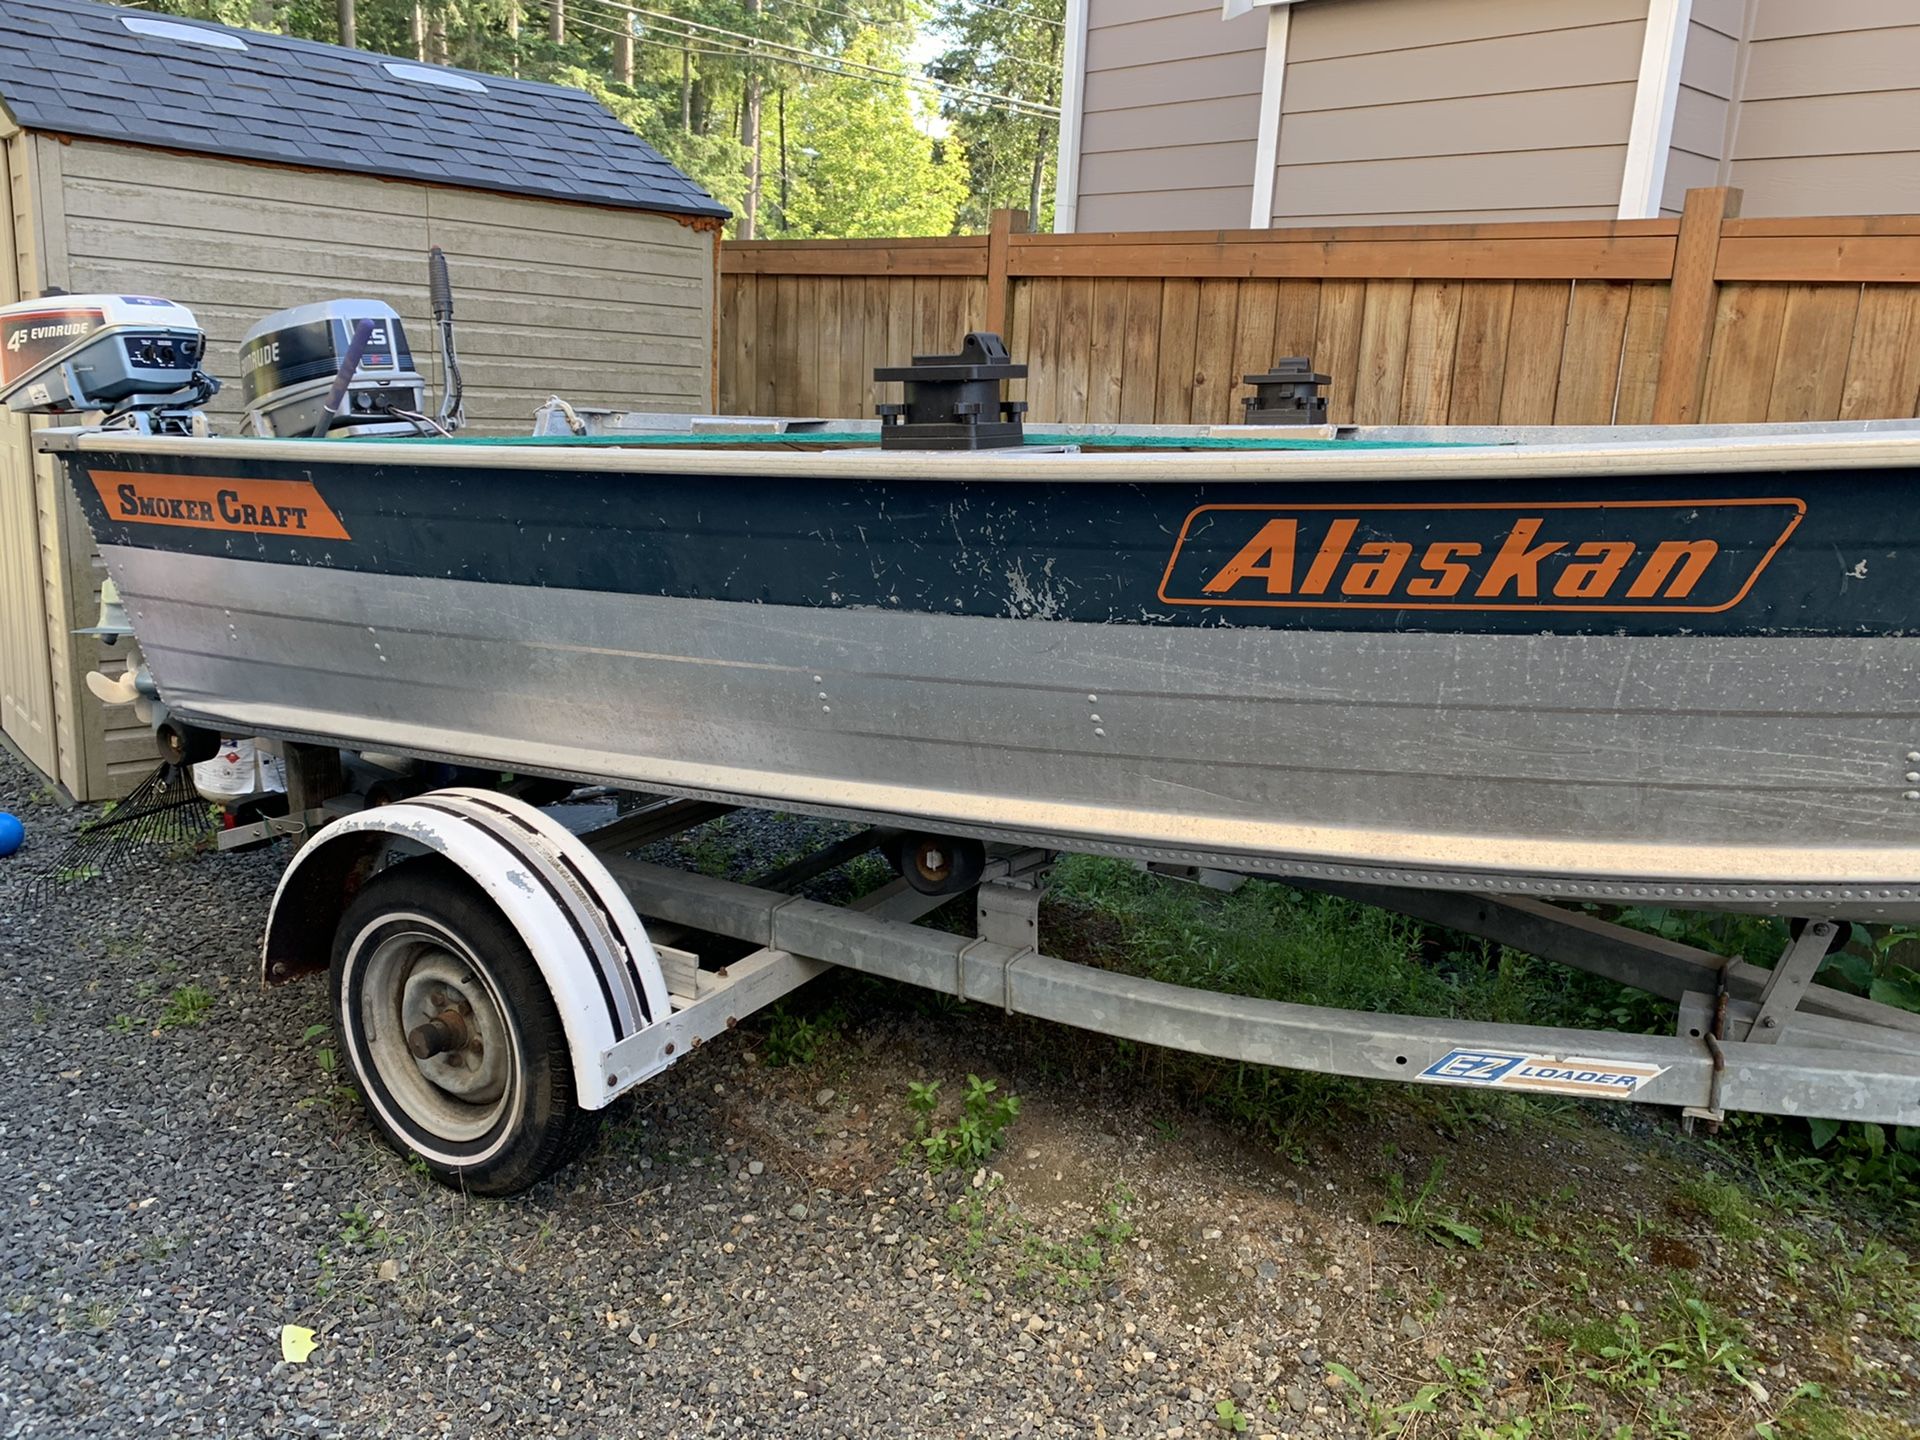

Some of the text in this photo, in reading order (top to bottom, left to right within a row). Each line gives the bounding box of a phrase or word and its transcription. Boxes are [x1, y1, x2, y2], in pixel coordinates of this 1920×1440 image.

[7, 322, 88, 352] 45 EVINRUDE
[1202, 518, 1718, 598] Alaskan
[1435, 1055, 1638, 1086] EZ LOADER
